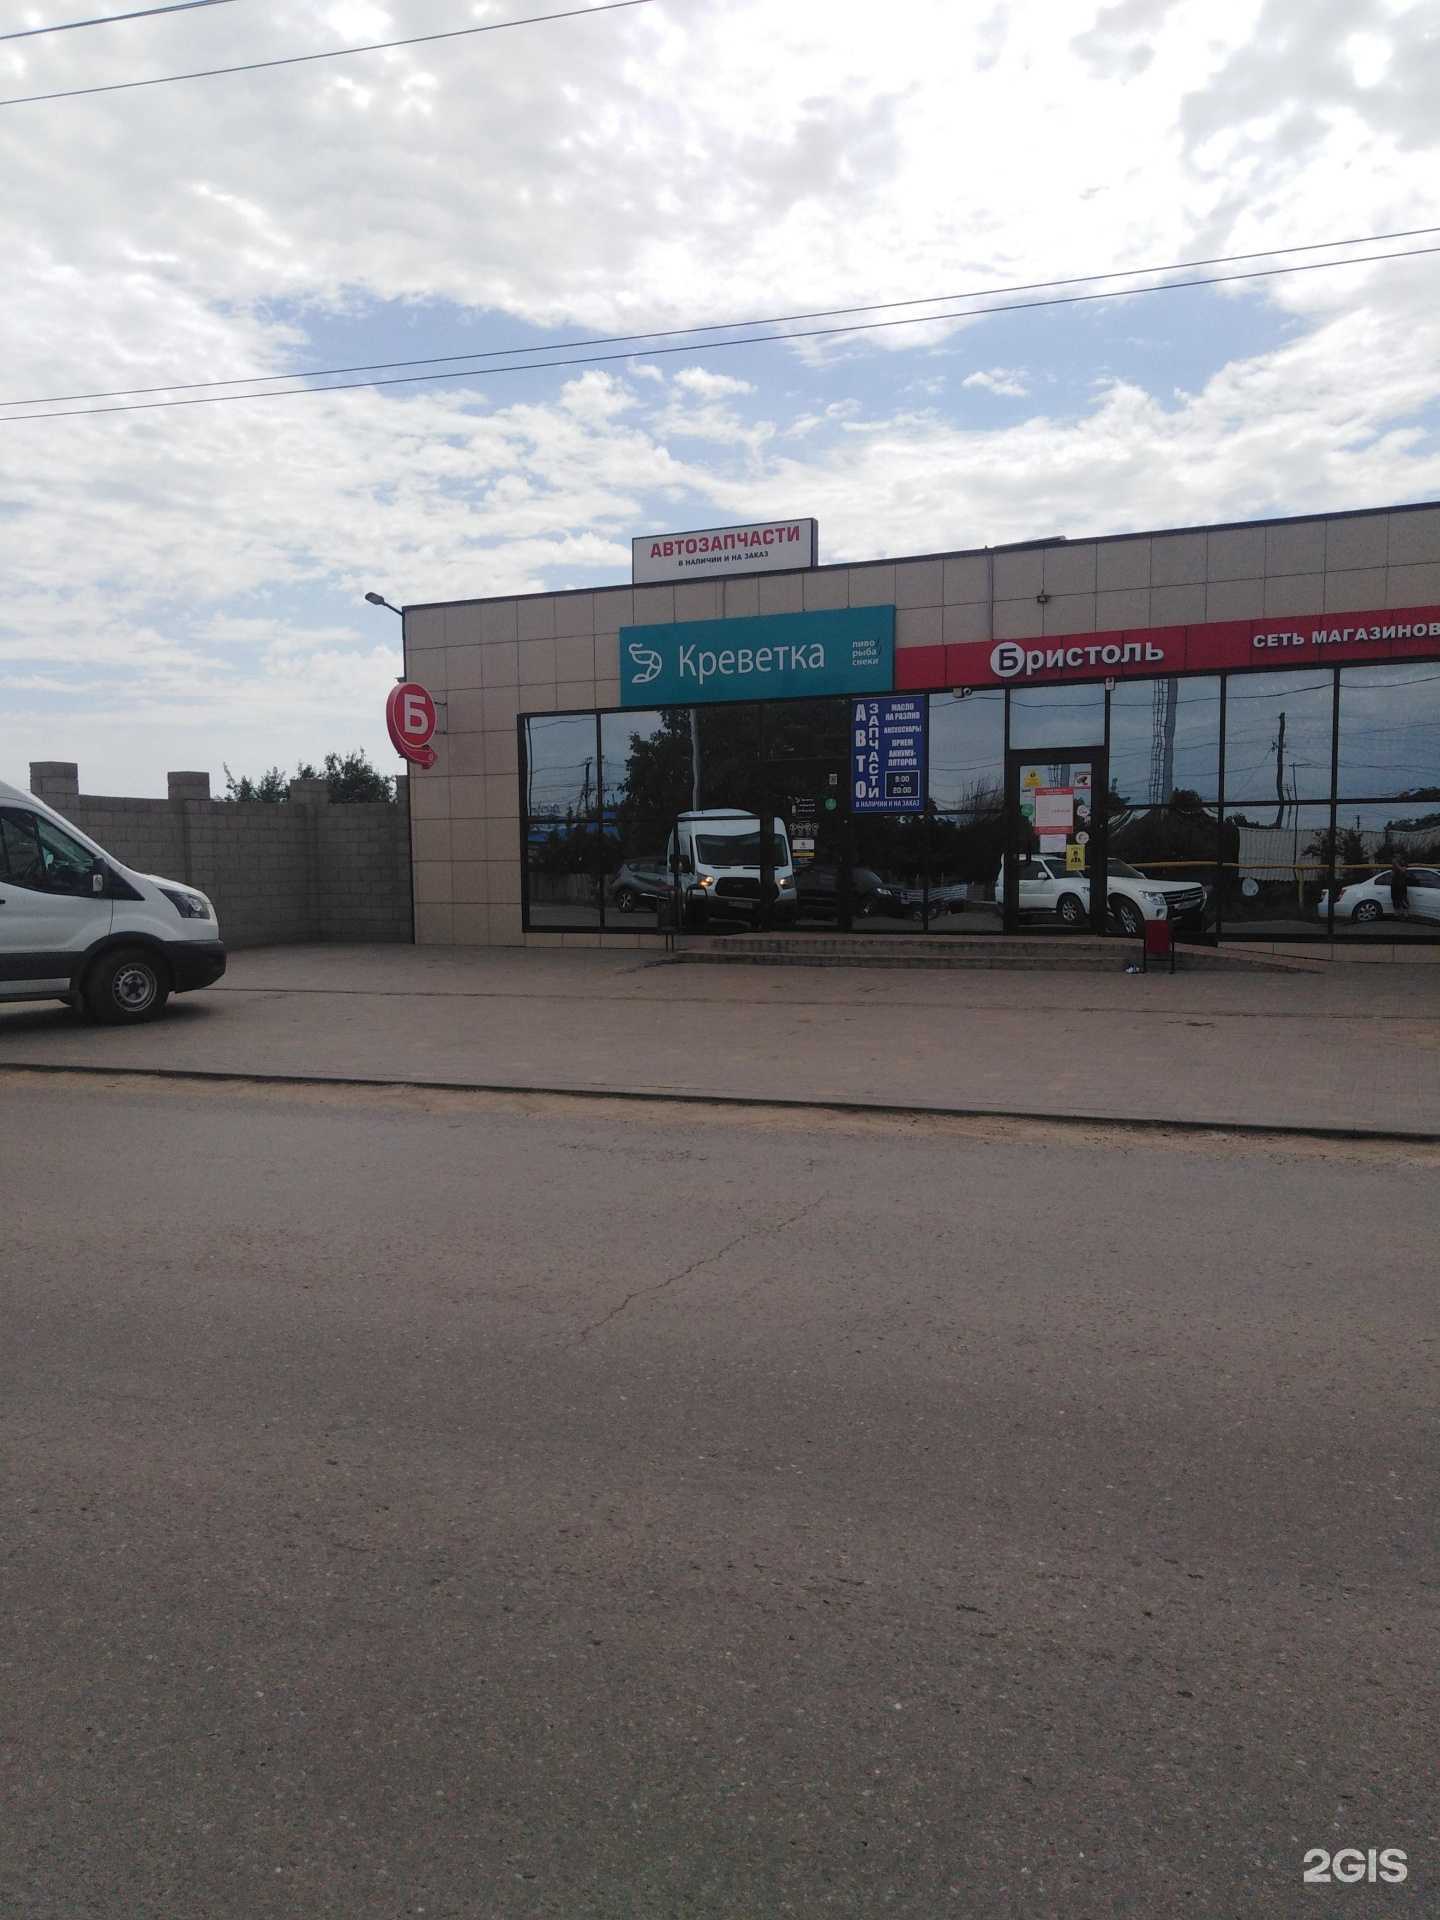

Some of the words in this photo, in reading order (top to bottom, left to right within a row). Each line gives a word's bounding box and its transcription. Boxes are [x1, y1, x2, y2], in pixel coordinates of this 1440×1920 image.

[650, 525, 800, 558] АВТОЗАПЧАСТИ
[685, 556, 722, 566] НАЛИЧИИ
[732, 553, 743, 562] НА
[745, 550, 769, 560] ЗАКАЗ
[852, 640, 876, 649] пиво
[1253, 632, 1305, 648] СЕТЬ
[1311, 622, 1440, 644] МАГАЗИНОВ
[679, 643, 825, 685] Креветка
[852, 647, 877, 658] рыба
[991, 642, 1165, 677] Бристоль
[404, 693, 429, 735] Б
[856, 704, 866, 799] АВТО
[868, 704, 879, 798] ЗАПЧАСТИ
